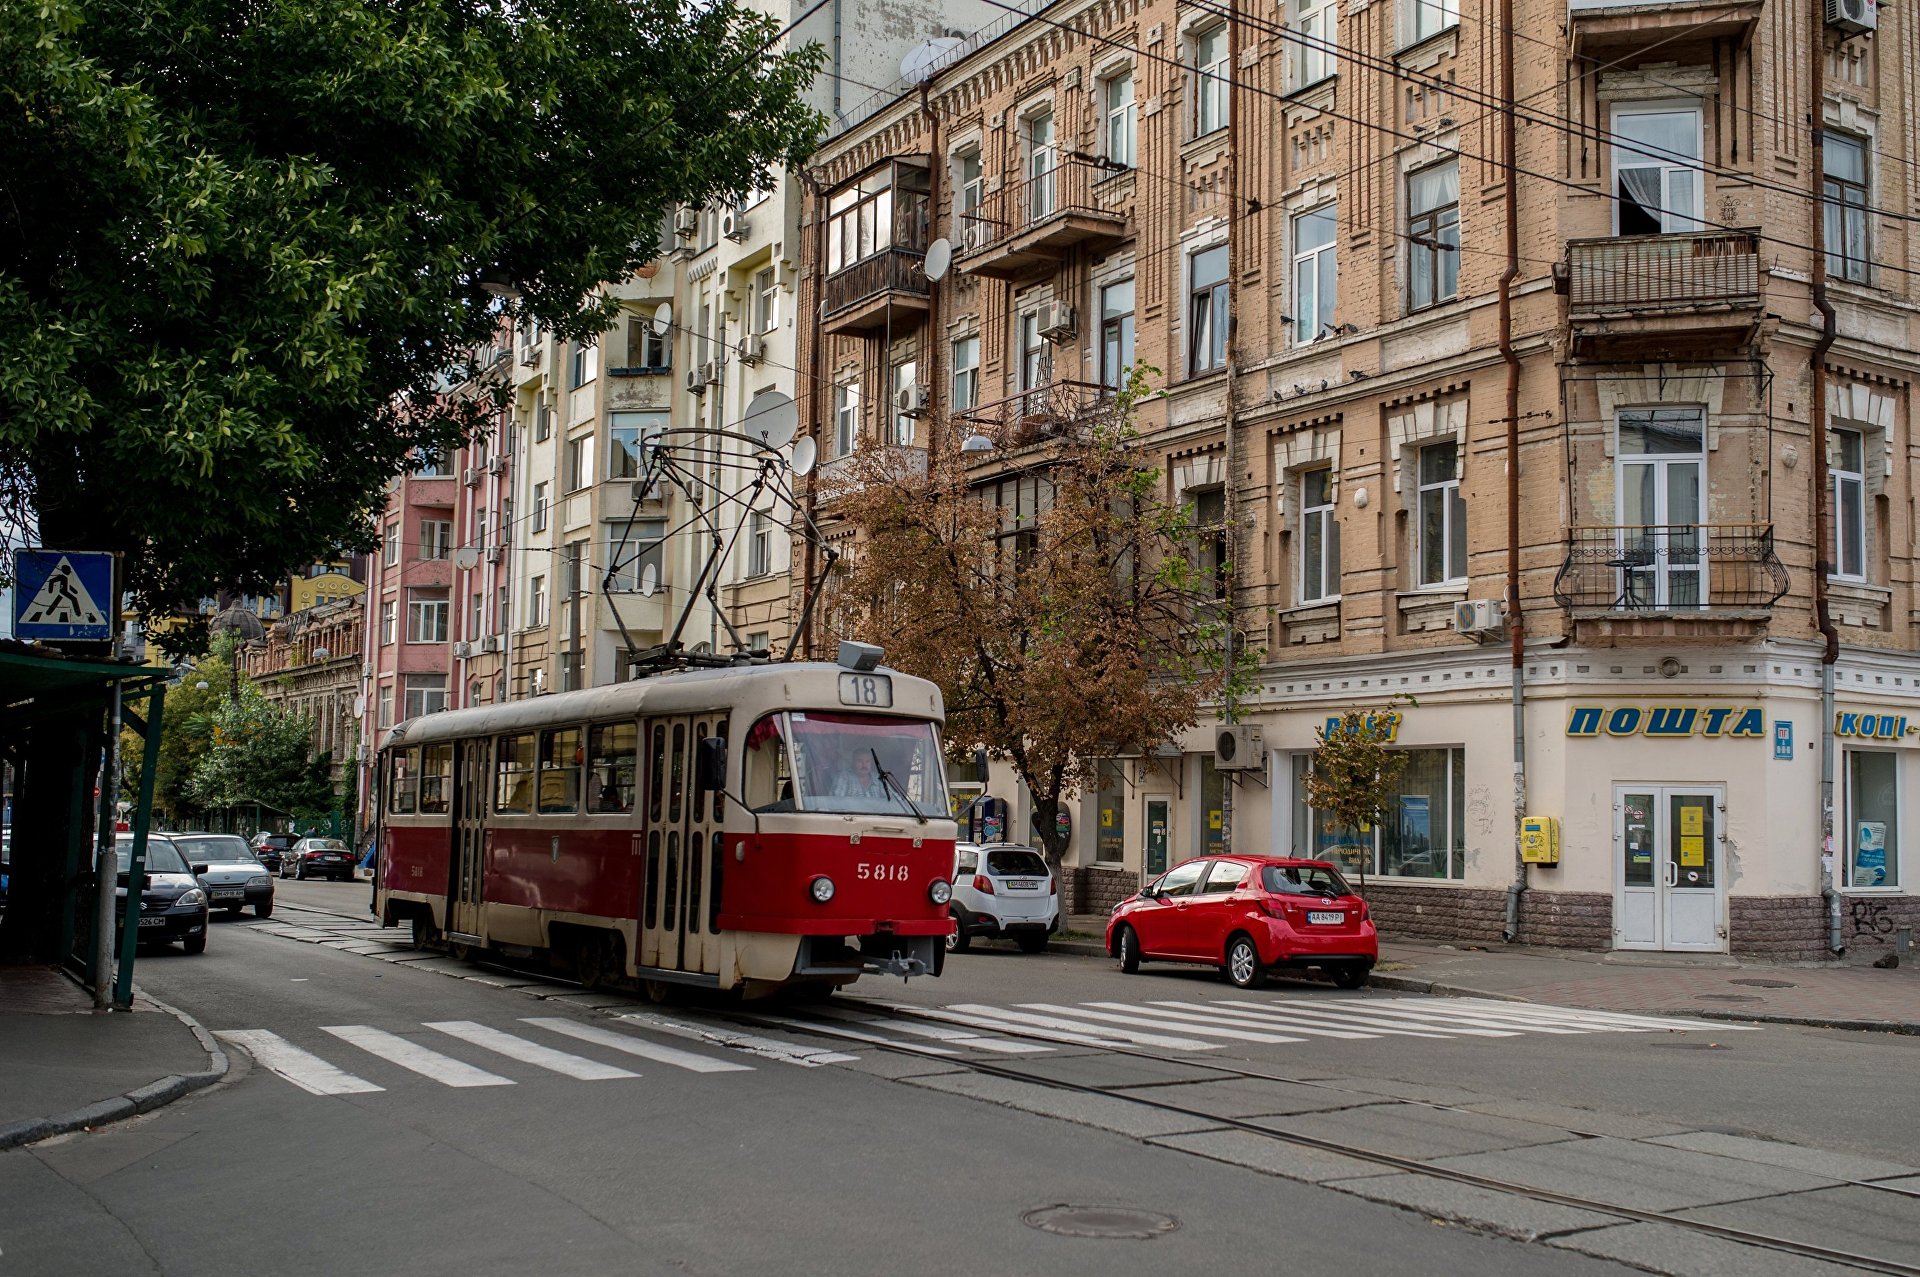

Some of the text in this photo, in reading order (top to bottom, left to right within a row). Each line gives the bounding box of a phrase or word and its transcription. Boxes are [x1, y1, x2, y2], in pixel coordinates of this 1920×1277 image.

[851, 676, 877, 705] 18
[1566, 706, 1766, 736] ПОШТА
[1836, 711, 1920, 740] КОПІ-
[857, 863, 909, 882] 5818
[138, 918, 152, 926] 526
